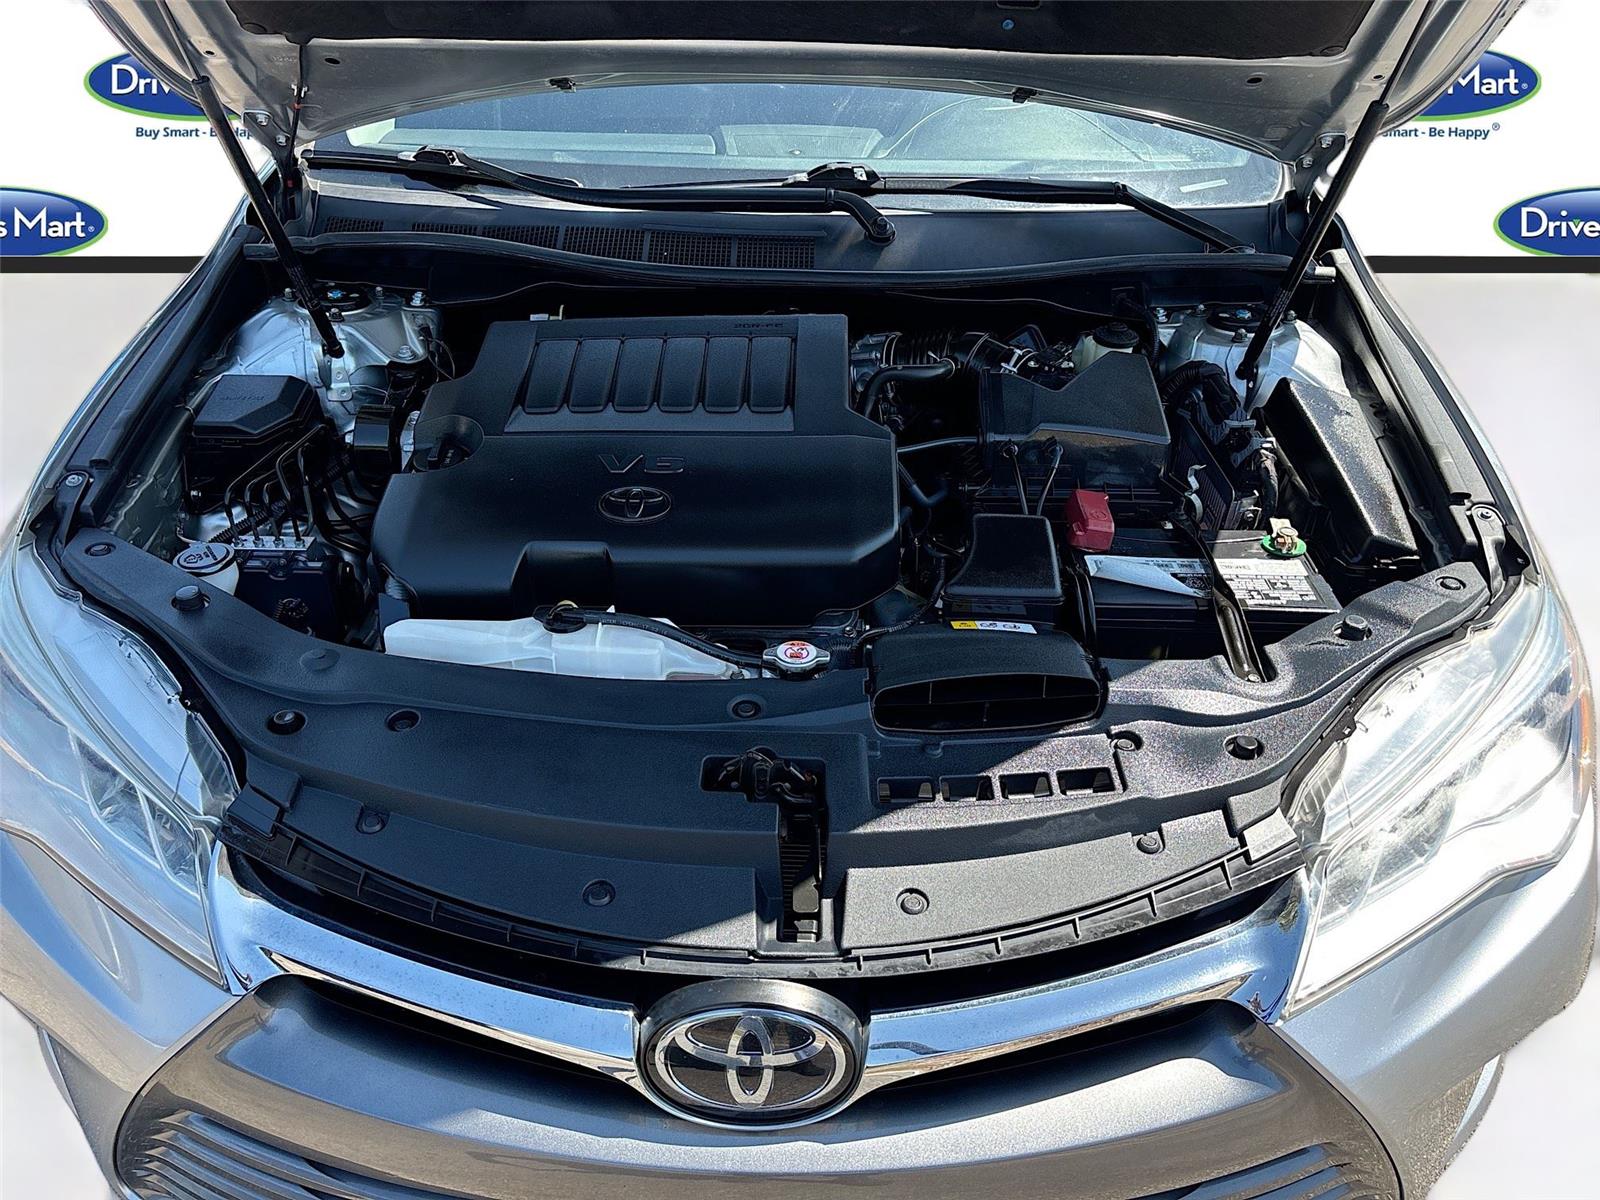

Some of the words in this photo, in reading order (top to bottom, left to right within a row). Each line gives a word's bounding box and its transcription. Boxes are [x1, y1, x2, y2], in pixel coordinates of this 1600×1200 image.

[1448, 64, 1519, 95] Mart
[136, 127, 158, 140] Buy
[163, 127, 199, 137] Smart
[1429, 127, 1445, 137] Be
[1449, 127, 1490, 140] Happy
[14, 206, 86, 238] Mart
[1521, 206, 1600, 238] Drive
[598, 454, 684, 474] V6
